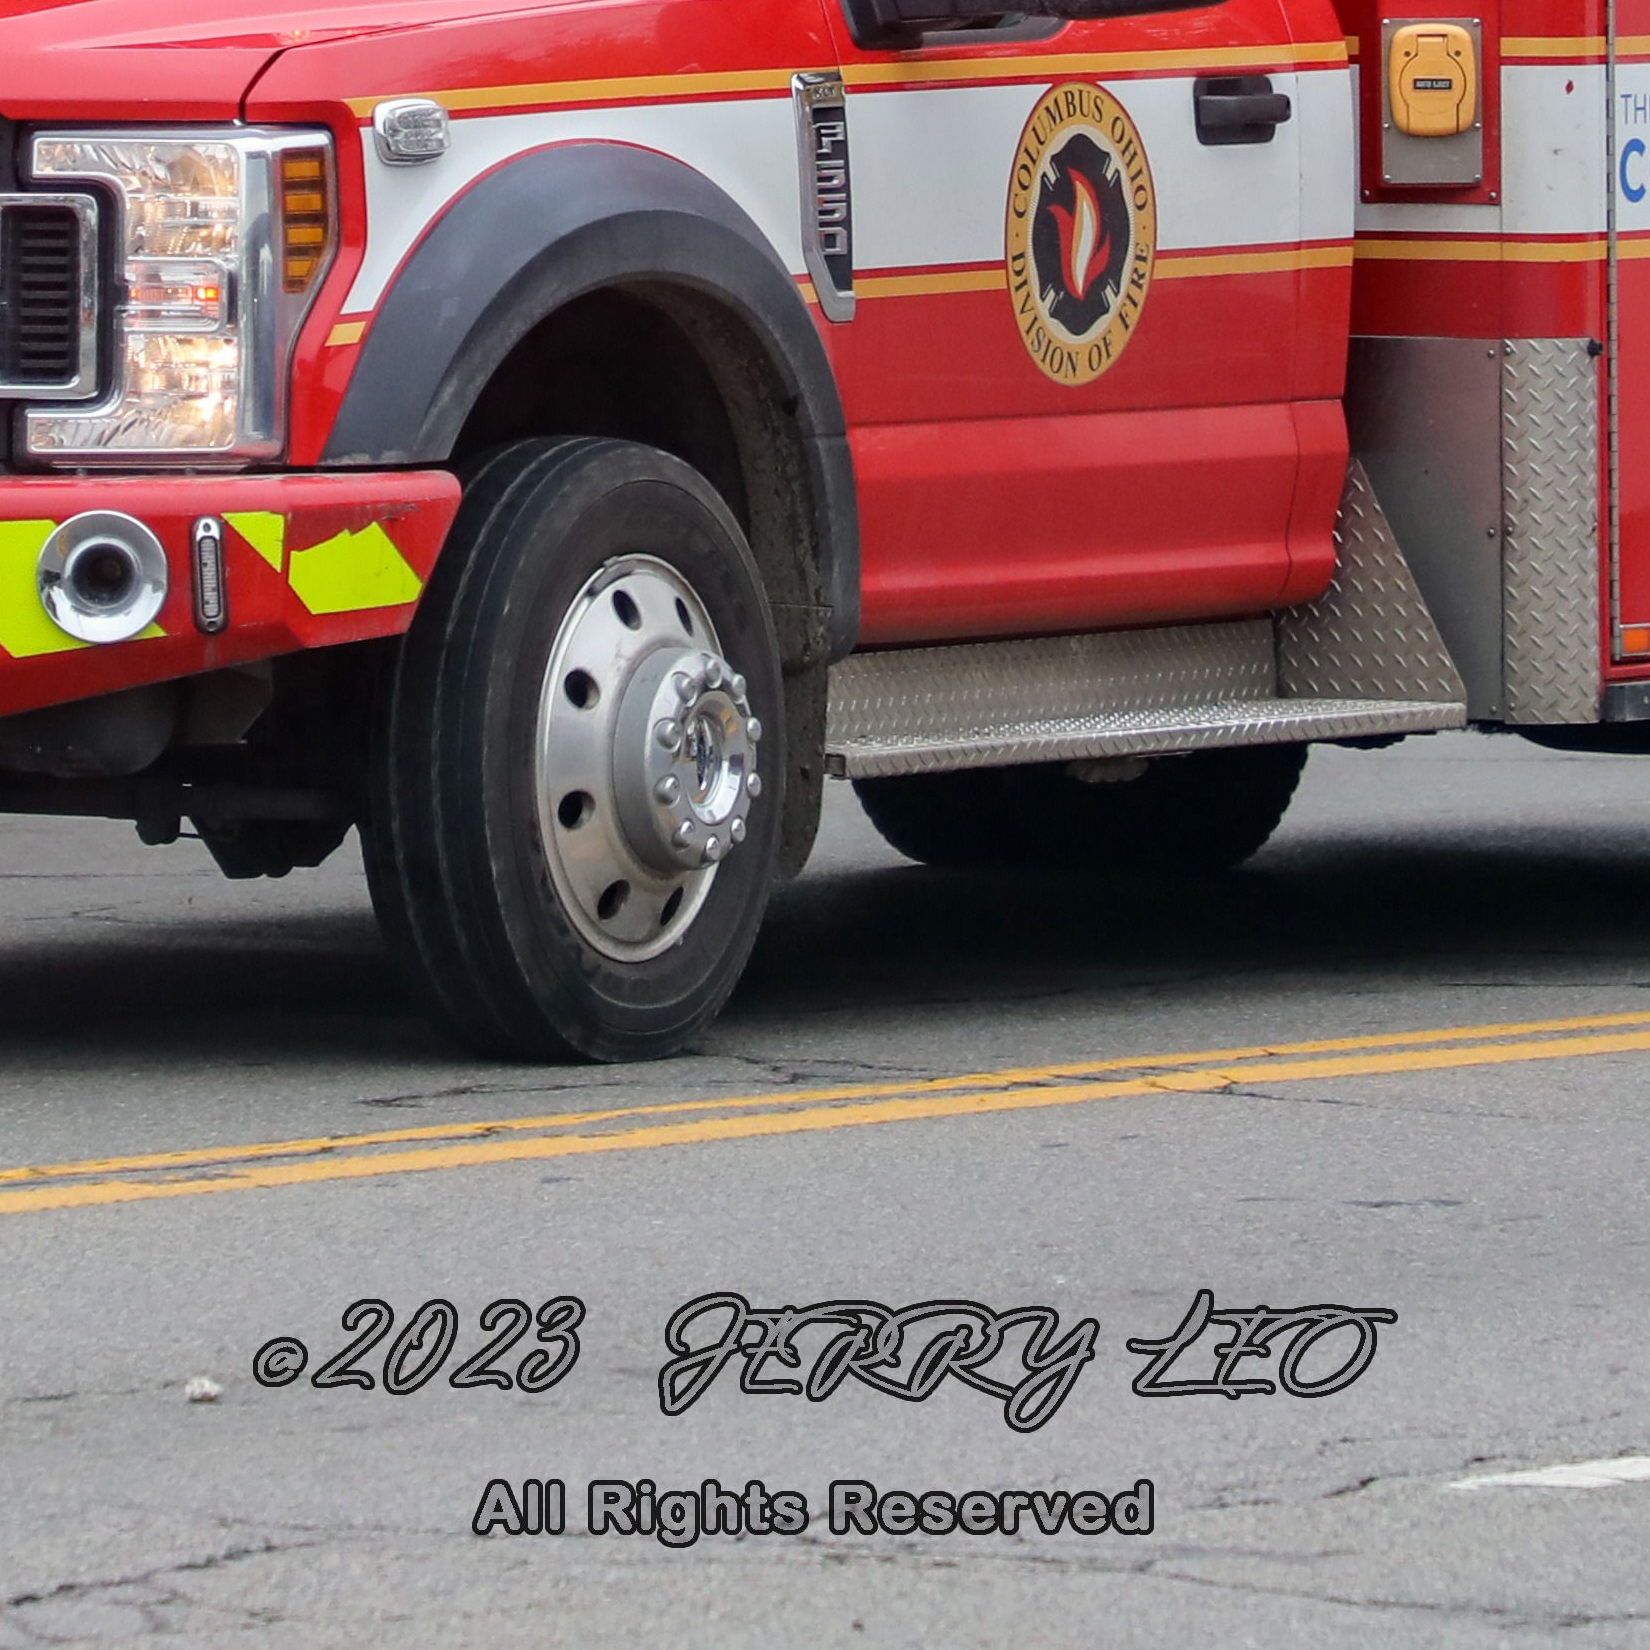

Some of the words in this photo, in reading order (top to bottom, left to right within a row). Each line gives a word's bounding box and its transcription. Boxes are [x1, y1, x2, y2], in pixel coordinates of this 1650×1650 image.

[1011, 88, 1105, 220] COLUMBUS
[1110, 115, 1150, 213] OHIO
[1010, 253, 1080, 379] DIVISION
[1087, 332, 1114, 373] OF
[1121, 241, 1150, 332] FIRE
